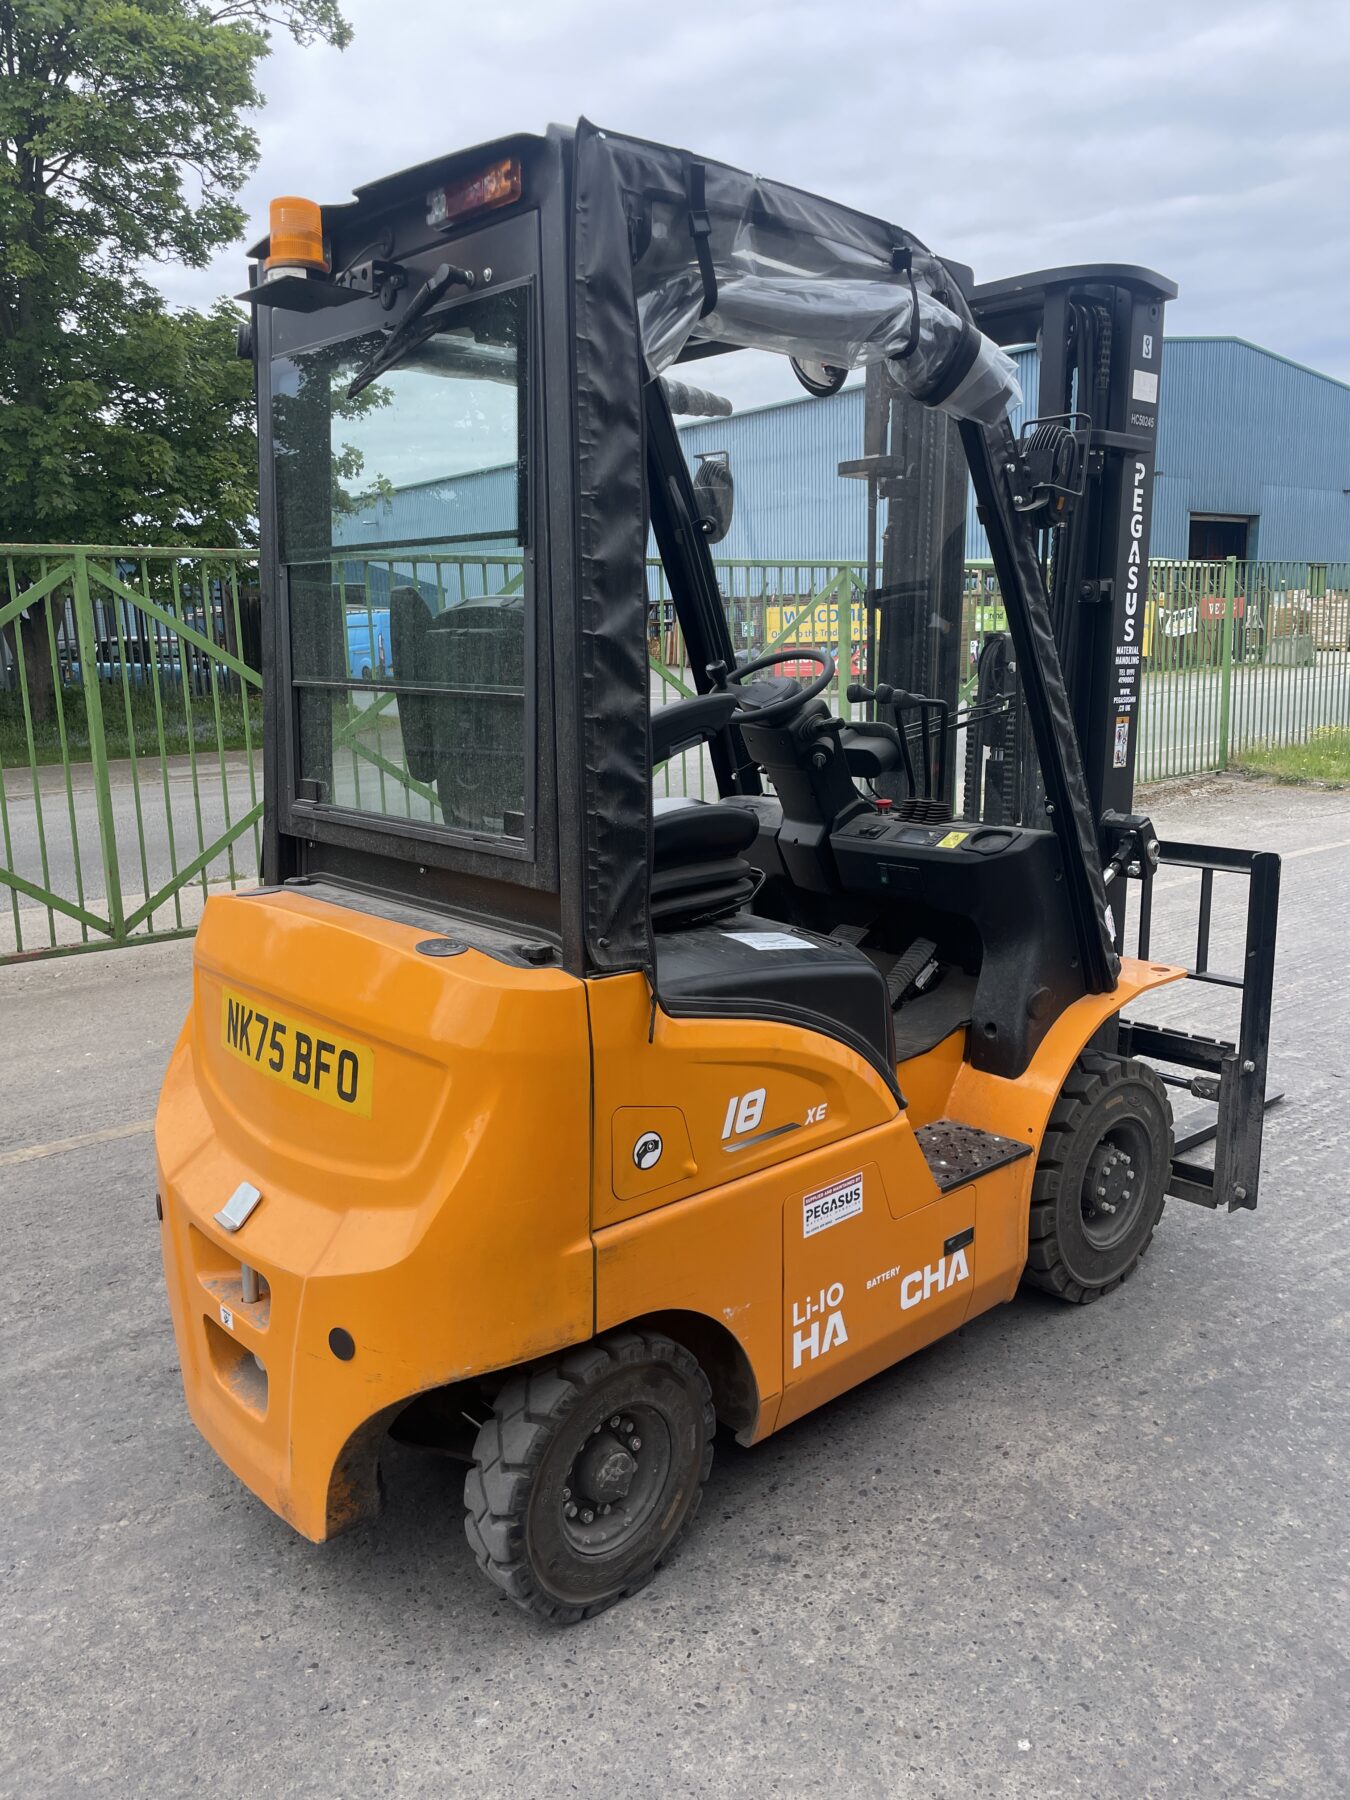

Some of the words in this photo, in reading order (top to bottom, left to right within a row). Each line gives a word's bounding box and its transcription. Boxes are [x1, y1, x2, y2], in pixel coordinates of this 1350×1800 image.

[1131, 413, 1155, 428] HC50245
[1123, 462, 1146, 642] PEGASUS
[783, 608, 866, 625] WCOE
[1115, 656, 1140, 665] HANDLING
[1116, 646, 1139, 655] MATERIAL
[227, 998, 287, 1073] NK75
[292, 1030, 359, 1104] BFO
[721, 1087, 767, 1141] 18
[804, 1102, 828, 1126] XE
[806, 1192, 824, 1204] SUPPLIED
[824, 1188, 832, 1196] AND
[832, 1179, 855, 1191] MAINTAINED
[805, 1187, 861, 1223] PEGASUS
[866, 1265, 901, 1290] BATTERY
[792, 1310, 848, 1369] HA
[900, 1248, 970, 1311] CHA
